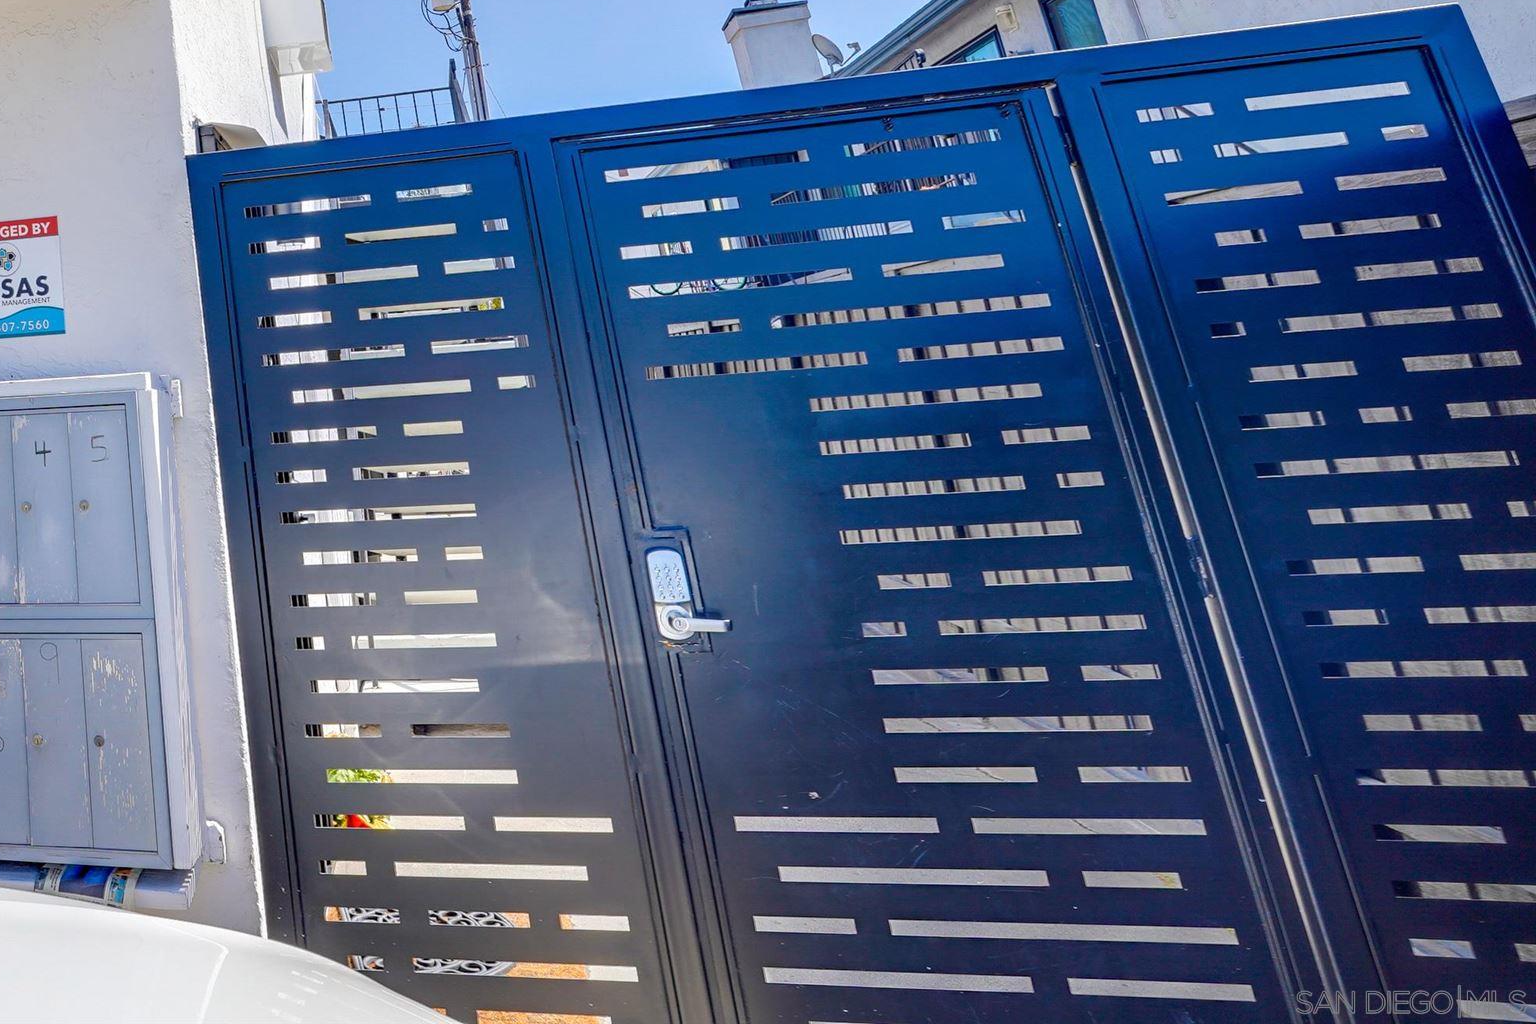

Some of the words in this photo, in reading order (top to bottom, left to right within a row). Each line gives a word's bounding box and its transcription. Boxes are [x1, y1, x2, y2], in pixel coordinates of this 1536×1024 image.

[32, 221, 51, 235] BY
[2, 296, 51, 306] MANAGEMENT
[34, 440, 52, 467] 4
[90, 434, 110, 463] 5
[39, 642, 61, 684] 9
